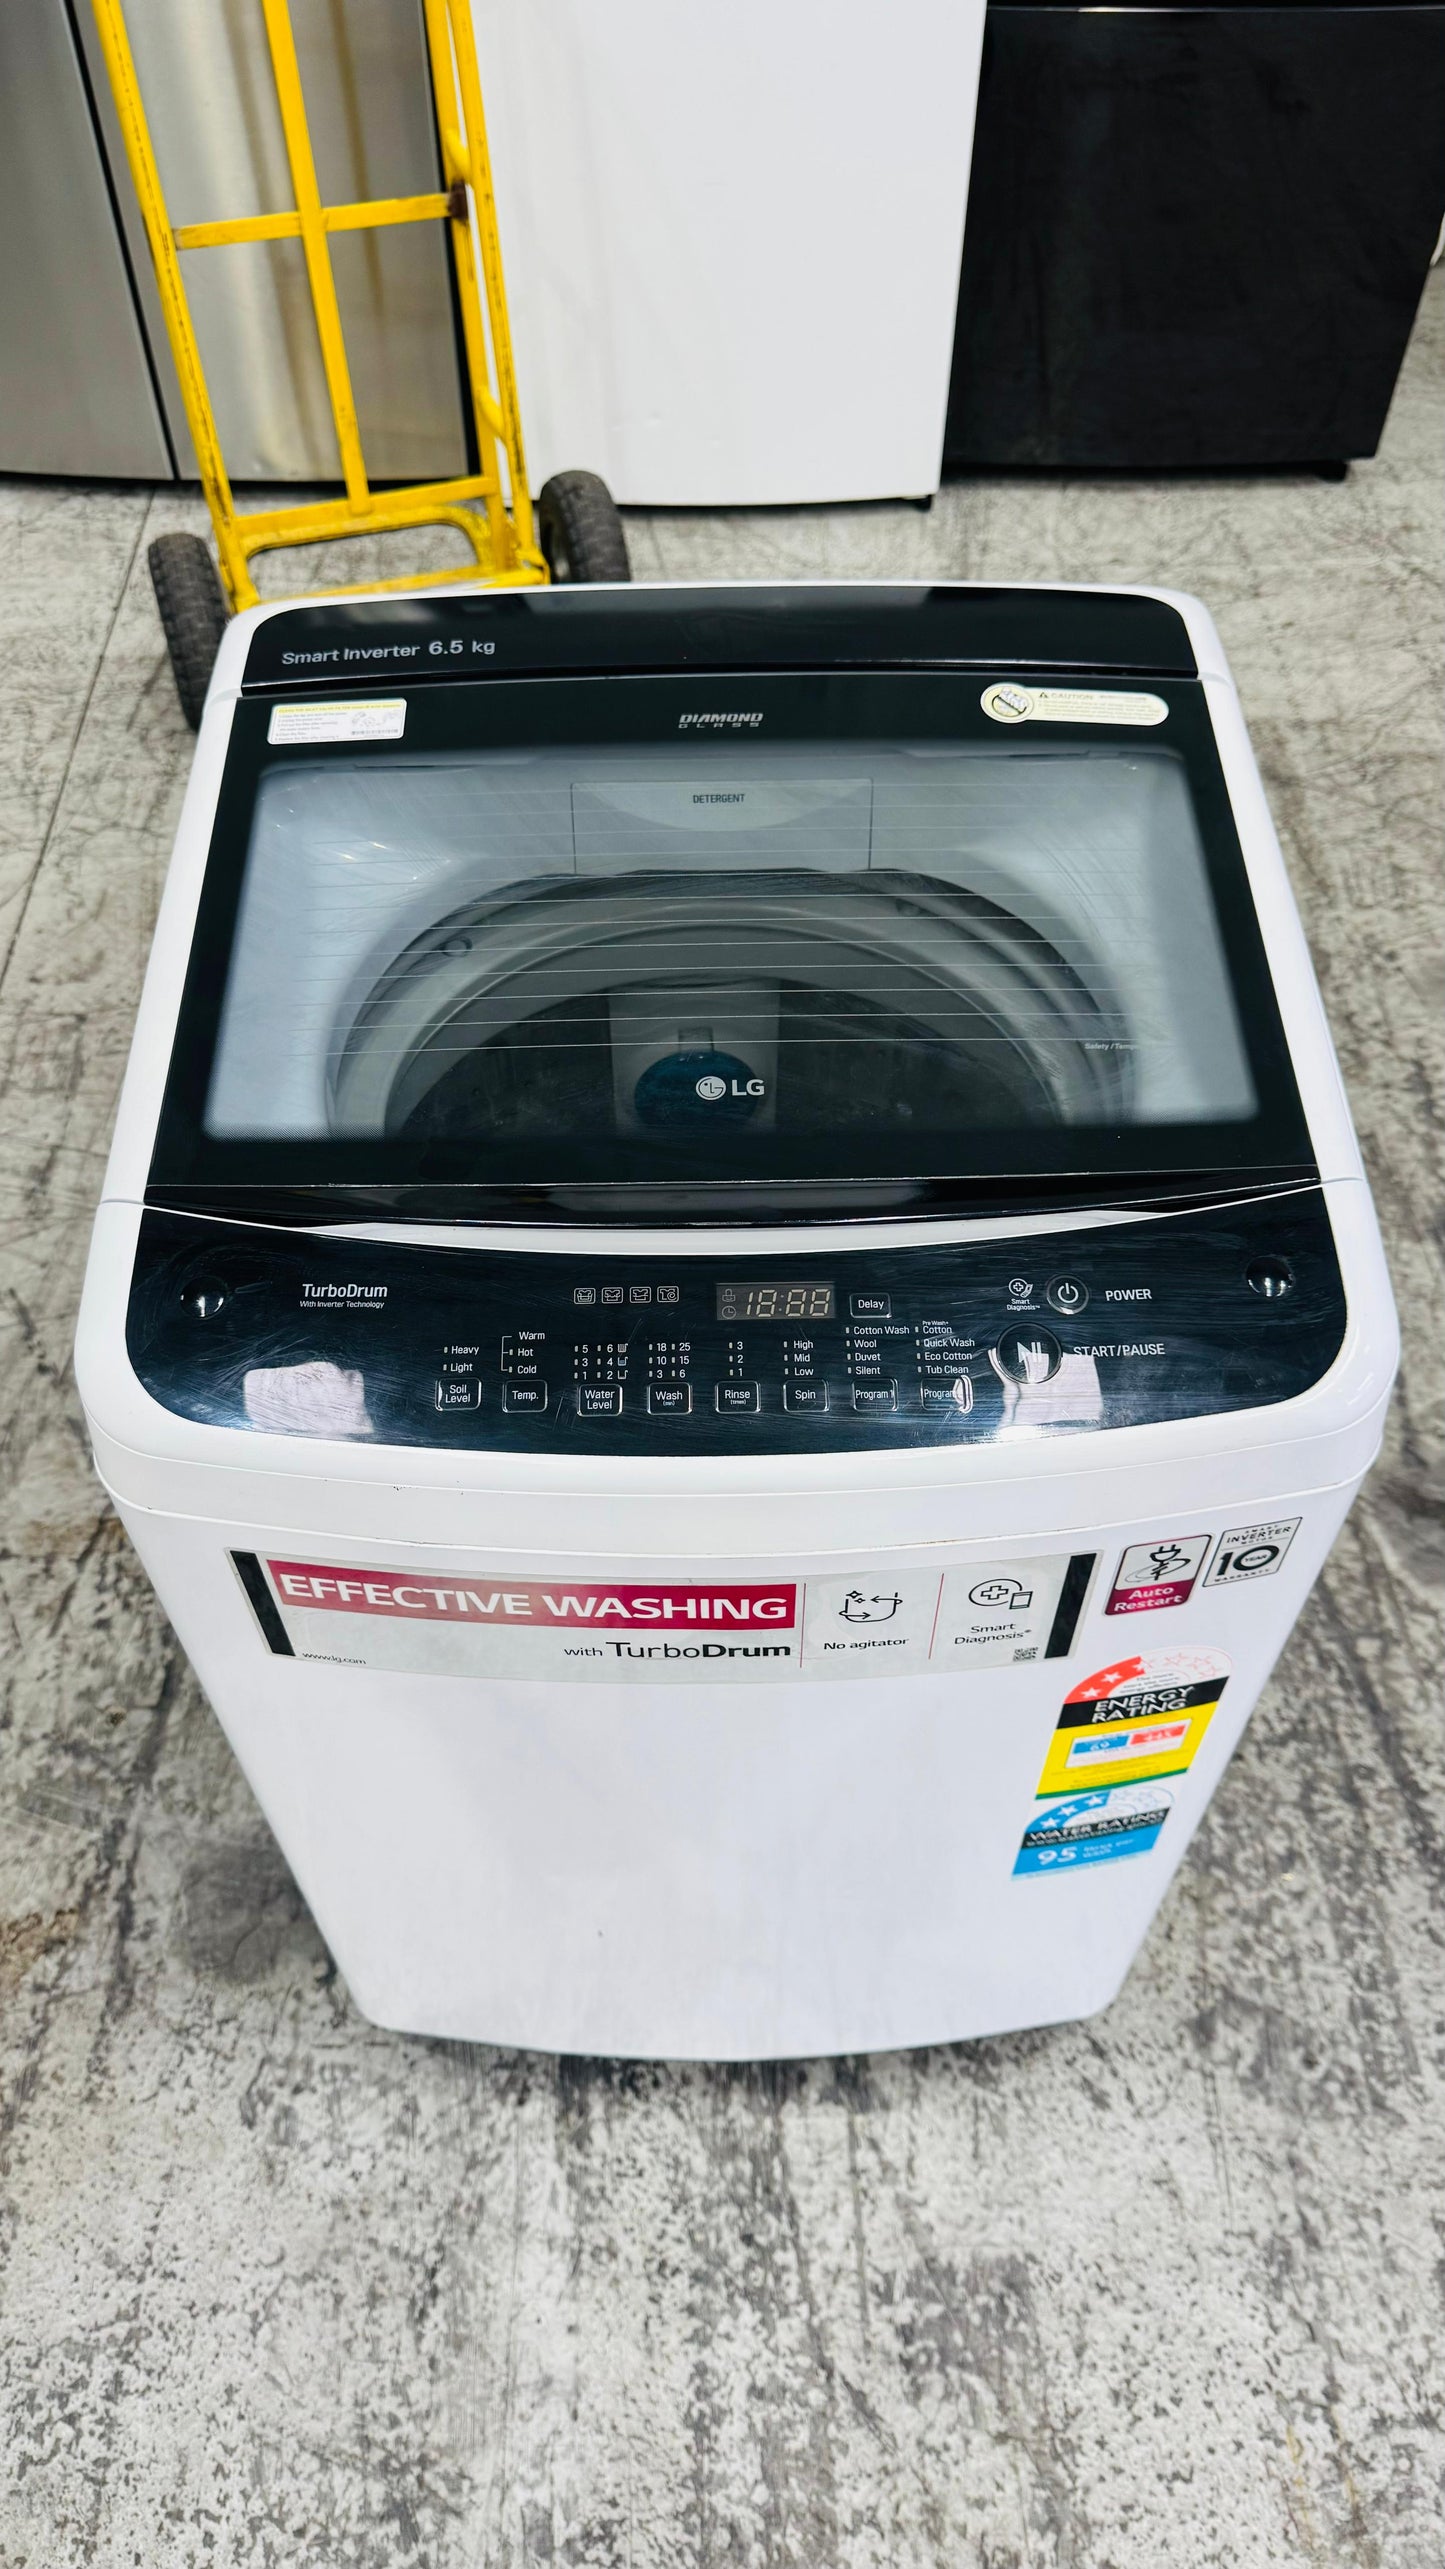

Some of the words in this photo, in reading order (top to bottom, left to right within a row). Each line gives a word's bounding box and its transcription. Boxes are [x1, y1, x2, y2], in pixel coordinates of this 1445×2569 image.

[282, 649, 340, 665] Smart
[343, 645, 421, 661] Inverter
[428, 640, 464, 655] 6.5
[471, 639, 496, 655] kg
[679, 713, 764, 724] DIAMOND
[692, 793, 745, 804] DETERGENT
[731, 1078, 766, 1097] LG
[302, 1283, 388, 1298] TurboDrum
[1105, 1288, 1152, 1302] POWER
[300, 1300, 317, 1308] With
[317, 1300, 345, 1308] Inverter
[346, 1300, 385, 1309] Technology
[858, 1299, 885, 1310] Delay
[853, 1326, 883, 1335] Cotton
[885, 1326, 910, 1335] Wash
[922, 1325, 952, 1334] Cotton
[518, 1331, 546, 1340] Warm
[656, 1343, 667, 1352] 18
[679, 1342, 691, 1351] 25
[736, 1341, 744, 1351] 3
[793, 1340, 814, 1350] High
[853, 1339, 877, 1348] Wool
[923, 1338, 949, 1348] Quick
[949, 1338, 975, 1347] Wash
[451, 1345, 480, 1355] Heavy
[517, 1348, 534, 1357] Hot
[582, 1344, 589, 1353] 5
[606, 1344, 614, 1353] 6
[1073, 1343, 1166, 1358] START/PAUSE
[656, 1355, 667, 1365] 10
[679, 1355, 690, 1365] 15
[737, 1355, 744, 1364] 2
[794, 1353, 811, 1363] Mid
[855, 1352, 881, 1361] Duvet
[924, 1352, 942, 1361] Eco
[942, 1351, 973, 1360] Cotton
[581, 1358, 589, 1367] 3
[606, 1357, 613, 1367] 4
[450, 1362, 473, 1373] Light
[517, 1365, 537, 1374] Cold
[794, 1367, 814, 1376] Low
[855, 1366, 881, 1375] Silent
[925, 1365, 943, 1374] Tub
[944, 1365, 969, 1374] Clean
[606, 1370, 613, 1380] 2
[656, 1369, 663, 1379] 3
[679, 1369, 686, 1379] 6
[449, 1384, 467, 1394] Soil
[584, 1389, 615, 1399] Water
[724, 1389, 751, 1399] Rinse
[445, 1393, 471, 1404] Level
[511, 1390, 539, 1402] Temp.
[655, 1390, 683, 1400] Wash
[795, 1389, 816, 1401] Spin
[855, 1389, 889, 1401] Program
[587, 1399, 612, 1410] Level
[1226, 1526, 1292, 1543] INVERTER
[1216, 1544, 1280, 1577] 10
[279, 1573, 533, 1615] EFFECTIVE
[541, 1594, 787, 1620] WASHING
[1128, 1585, 1175, 1600] Auto
[1113, 1594, 1184, 1612] Restart
[970, 1623, 1017, 1634] Smart
[824, 1641, 846, 1650] No
[850, 1637, 910, 1651] agitator
[564, 1646, 603, 1656] with
[605, 1641, 791, 1658] TurboDrum
[302, 1652, 367, 1667] www.lg.com
[1094, 1685, 1195, 1712] ENERGY
[1091, 1698, 1187, 1724] RATING
[1030, 1824, 1092, 1841] WATER
[1037, 1845, 1078, 1866] 95
